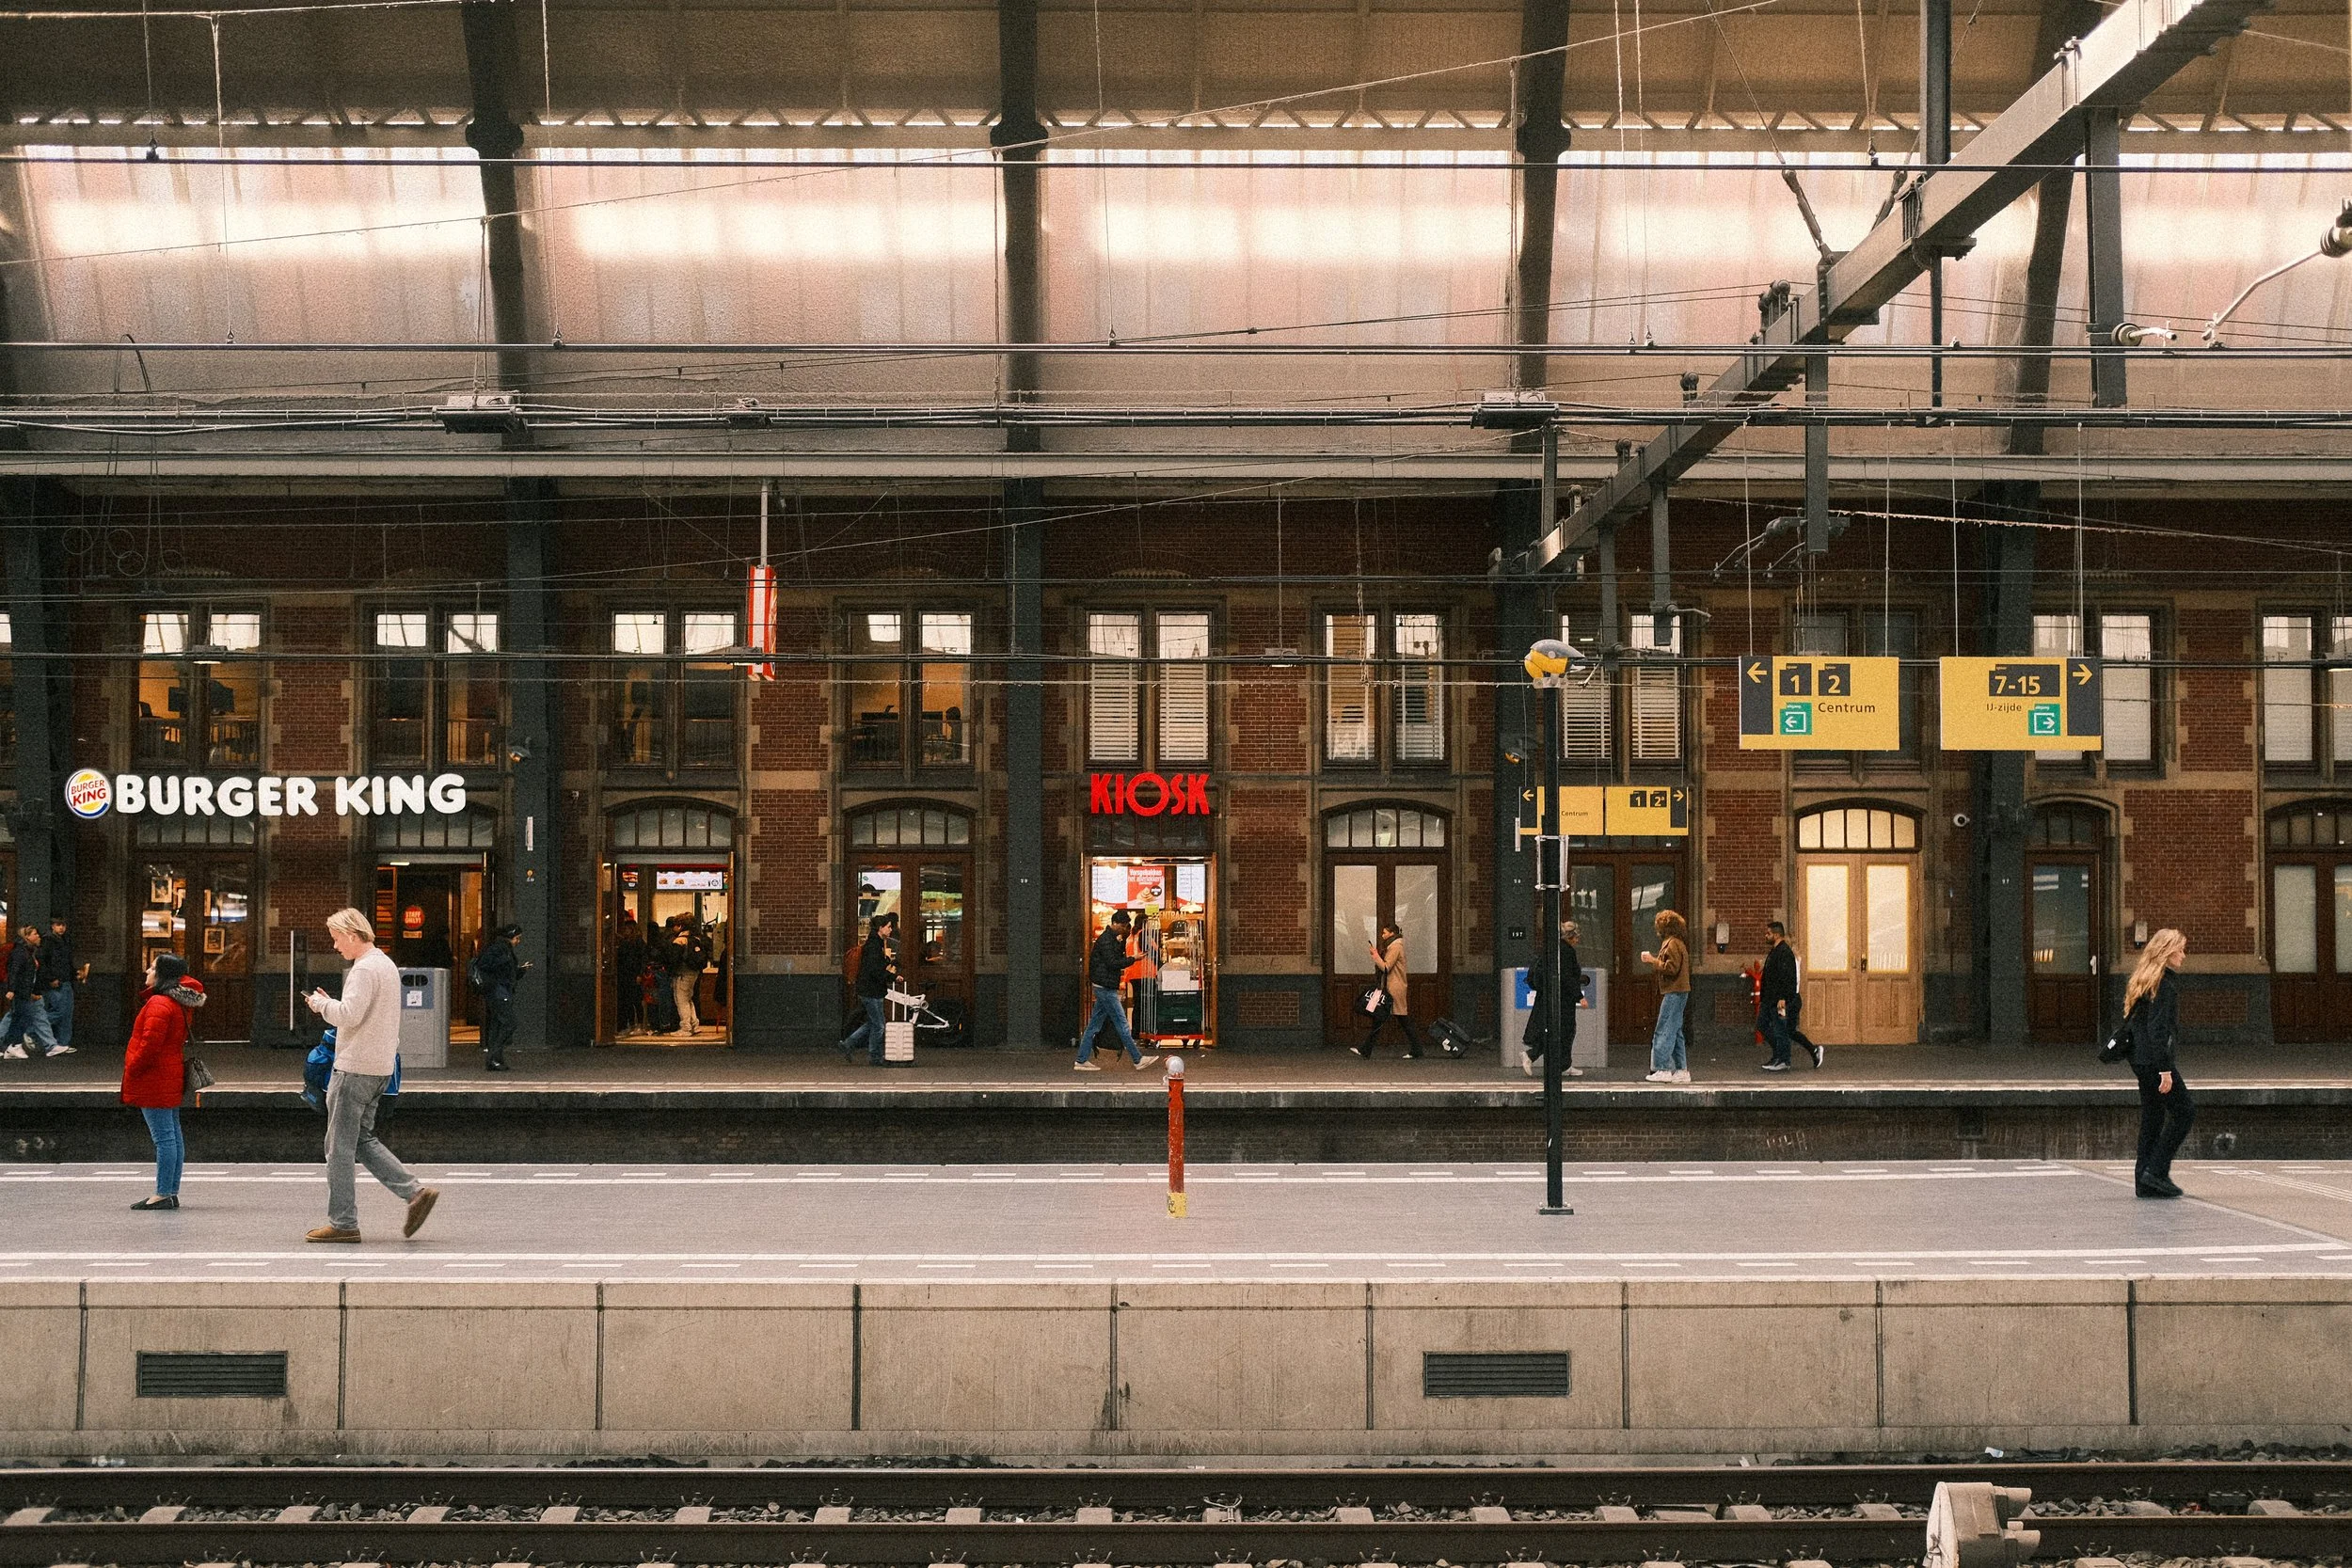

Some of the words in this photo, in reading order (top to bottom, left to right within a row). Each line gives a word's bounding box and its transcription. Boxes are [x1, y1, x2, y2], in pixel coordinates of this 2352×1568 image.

[1790, 674, 1800, 693] 1
[1827, 674, 1841, 694] 2
[1994, 675, 2041, 695] 7-15
[1818, 702, 1876, 713] Centrum
[1986, 703, 2022, 714] IJ-zijde
[71, 779, 105, 795] BURGER
[116, 771, 319, 817] BURGER
[335, 772, 467, 816] KING
[1090, 771, 1211, 817] KIOSK
[72, 787, 106, 807] KING
[1635, 796, 1641, 807] 1
[1157, 911, 1186, 920] ENTRAAL
